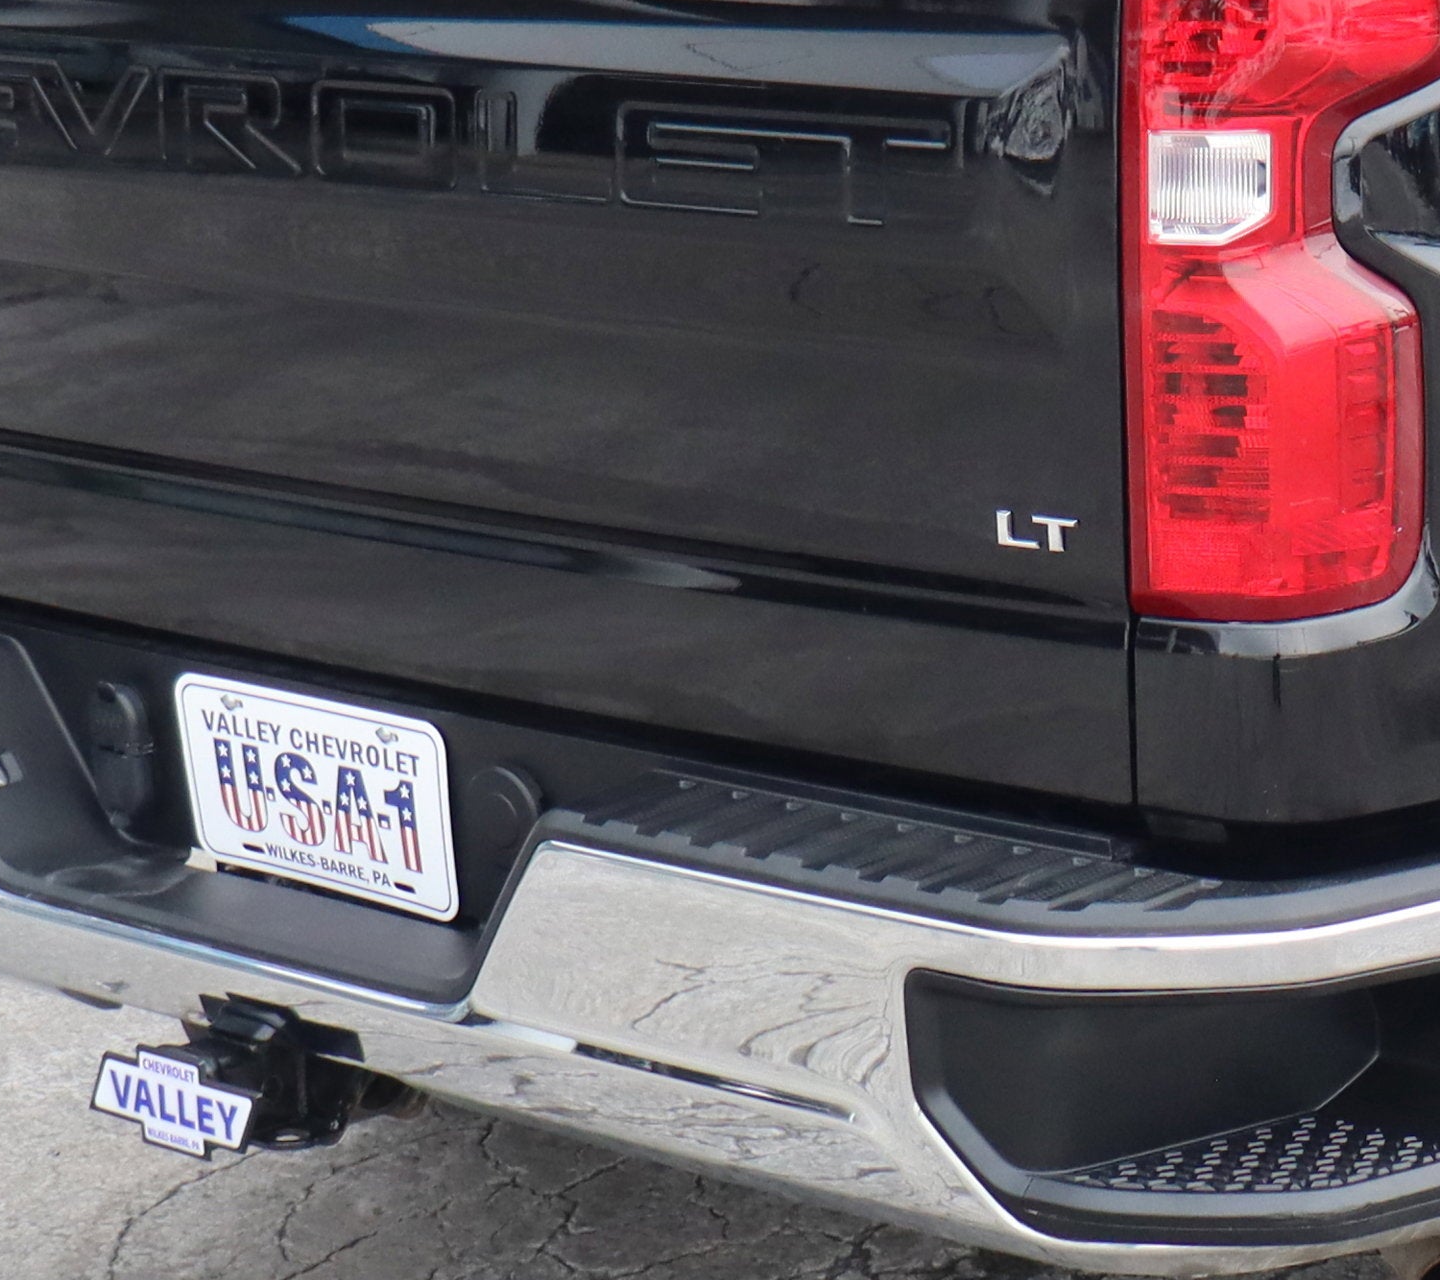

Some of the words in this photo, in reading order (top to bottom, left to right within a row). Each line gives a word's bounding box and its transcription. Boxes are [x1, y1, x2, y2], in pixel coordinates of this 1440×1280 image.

[995, 509, 1079, 552] LT
[201, 708, 282, 745] VALLEY
[289, 727, 420, 777] CHEVROLET
[265, 843, 370, 884] WILKES-BARRE,
[372, 870, 391, 888] PA
[142, 1058, 196, 1084] CHEVROLET
[110, 1070, 238, 1141] VALLEY
